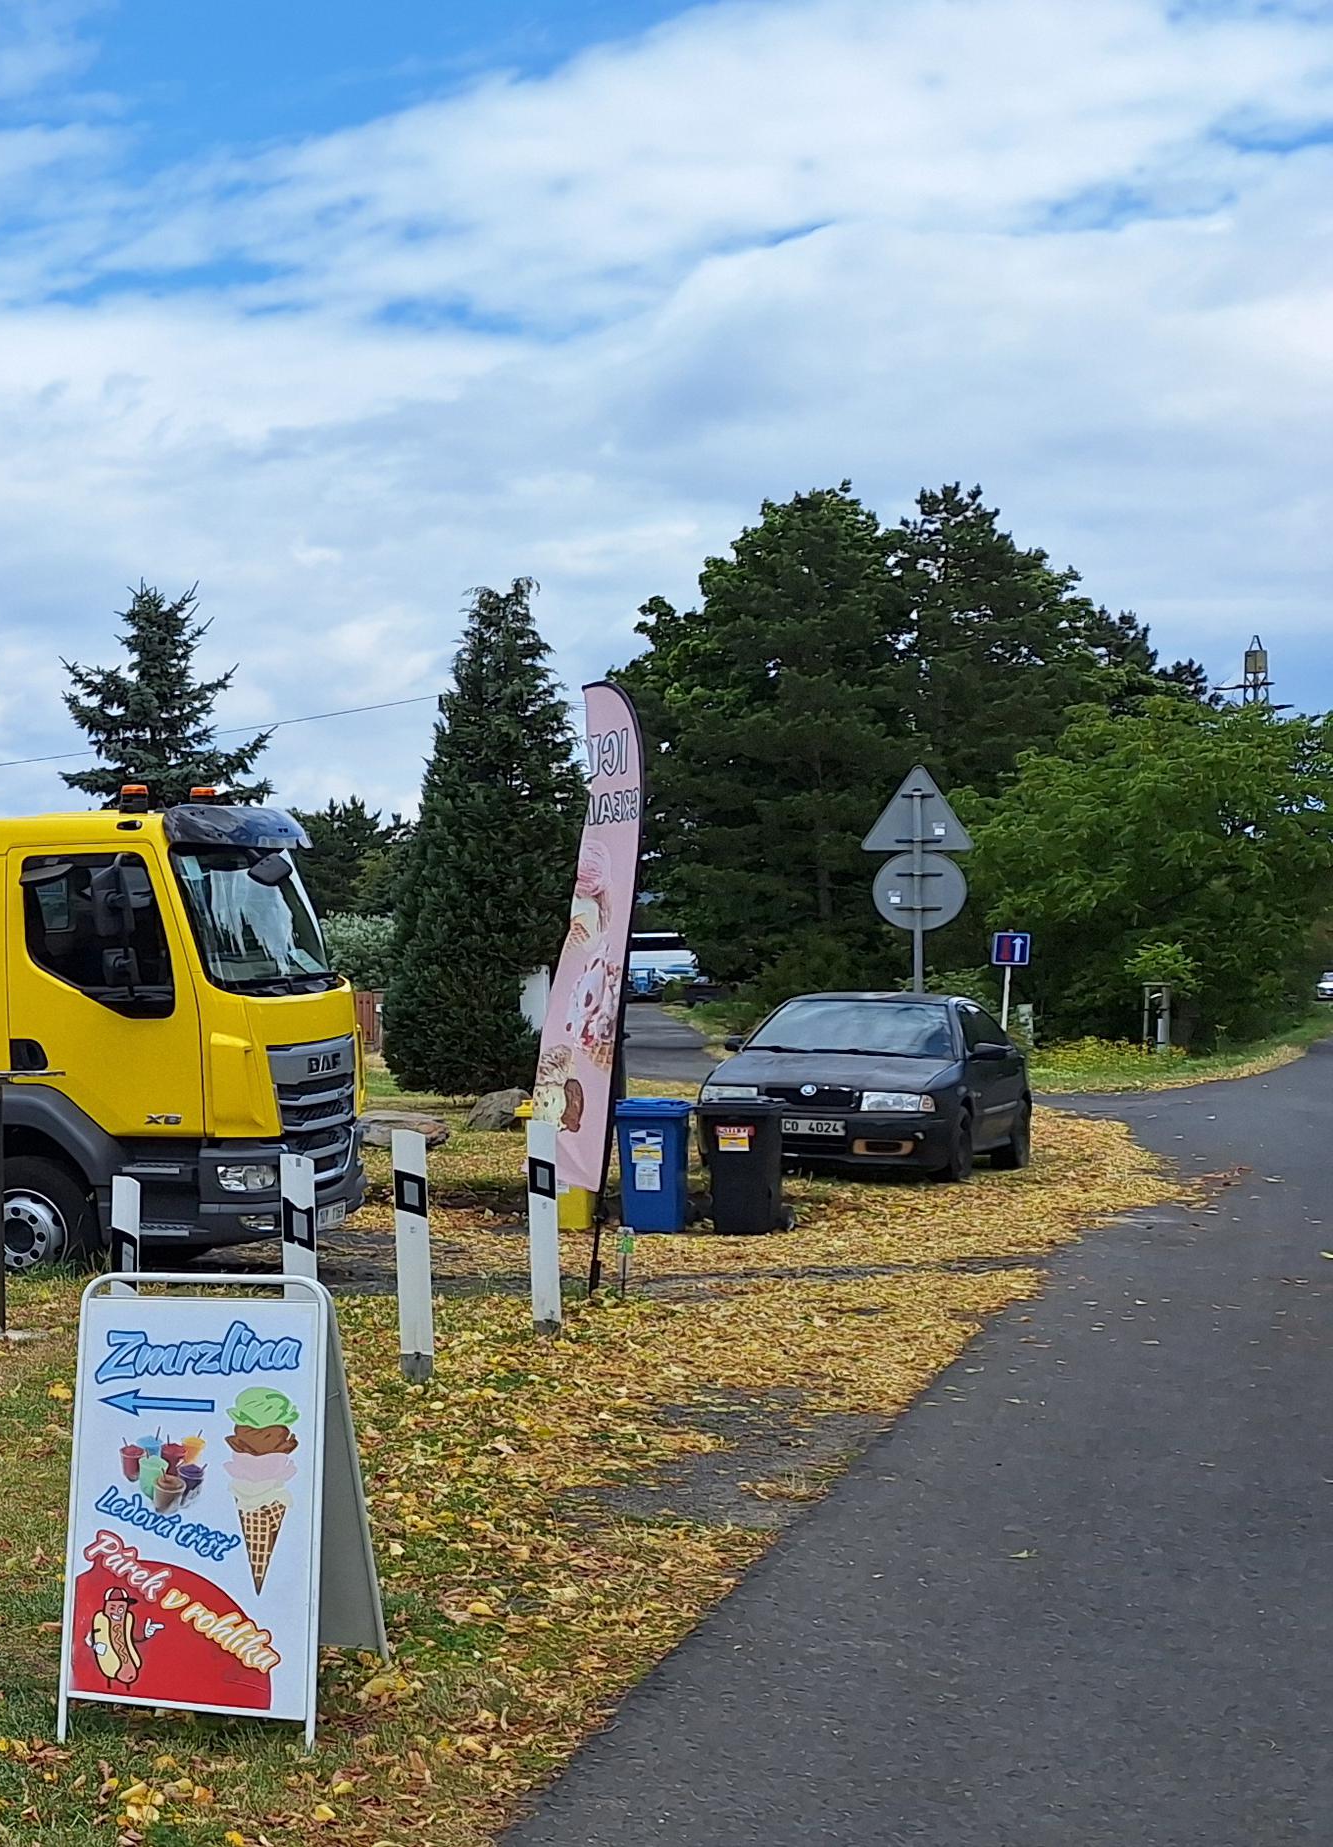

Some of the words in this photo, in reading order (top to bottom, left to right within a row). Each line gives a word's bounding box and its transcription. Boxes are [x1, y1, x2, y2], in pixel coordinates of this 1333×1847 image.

[307, 1052, 341, 1075] DAF
[808, 1122, 840, 1134] 4024
[94, 1320, 303, 1384] Zmrzlina
[94, 1485, 179, 1538] Ledová
[173, 1520, 241, 1563] tříšť
[84, 1529, 173, 1603] Párek
[161, 1588, 185, 1612] v
[180, 1598, 282, 1673] rohlíku
